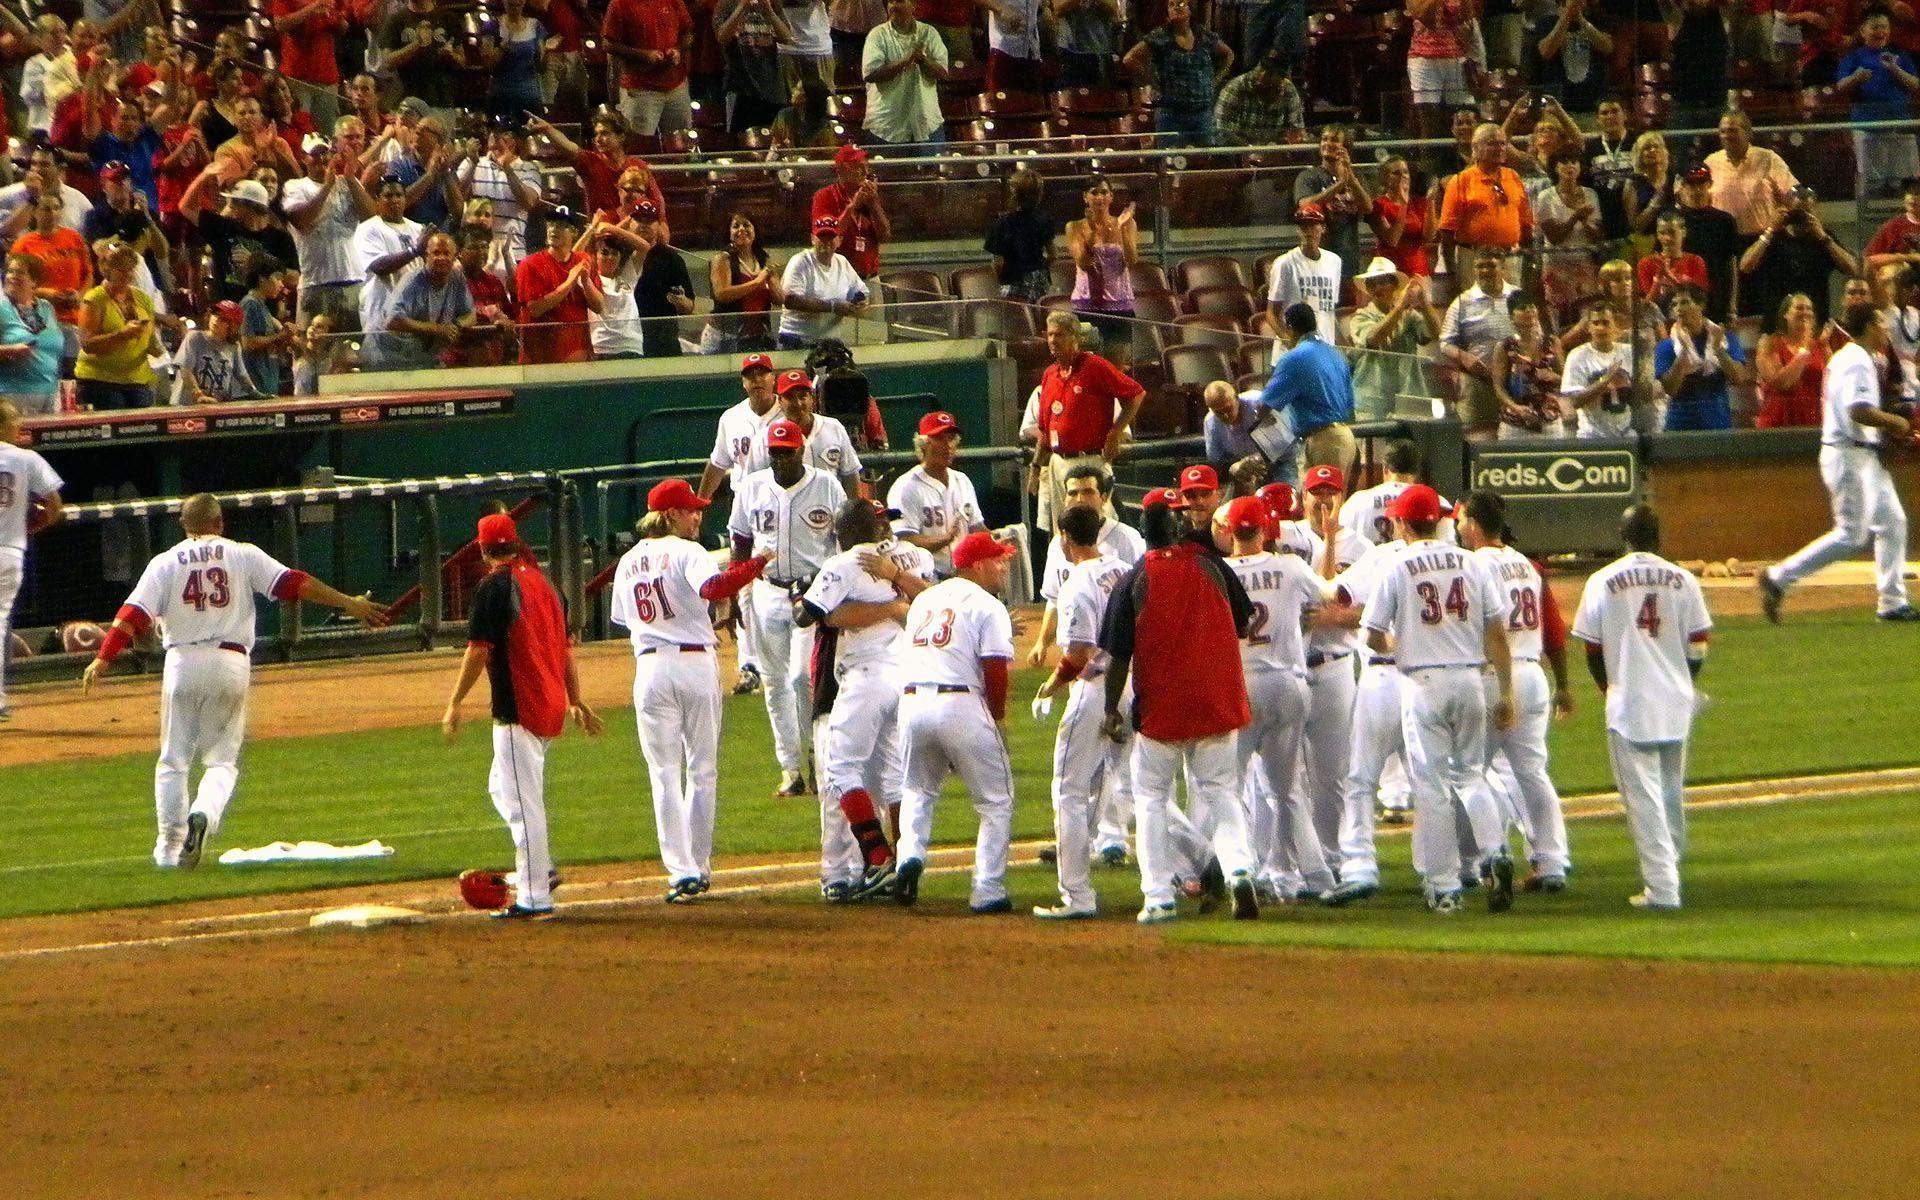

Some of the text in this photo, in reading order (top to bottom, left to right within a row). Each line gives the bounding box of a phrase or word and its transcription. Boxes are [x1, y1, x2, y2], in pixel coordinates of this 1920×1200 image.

[754, 509, 775, 532] 12
[625, 553, 669, 579] ARRYO
[1405, 552, 1464, 576] BAILEY
[1606, 567, 1685, 594] PHILLIPS
[182, 567, 230, 611] 43
[634, 576, 676, 624] 61
[1416, 576, 1469, 625] 34
[1509, 586, 1539, 631] 28
[912, 607, 956, 649] 23
[1636, 592, 1660, 637] 4
